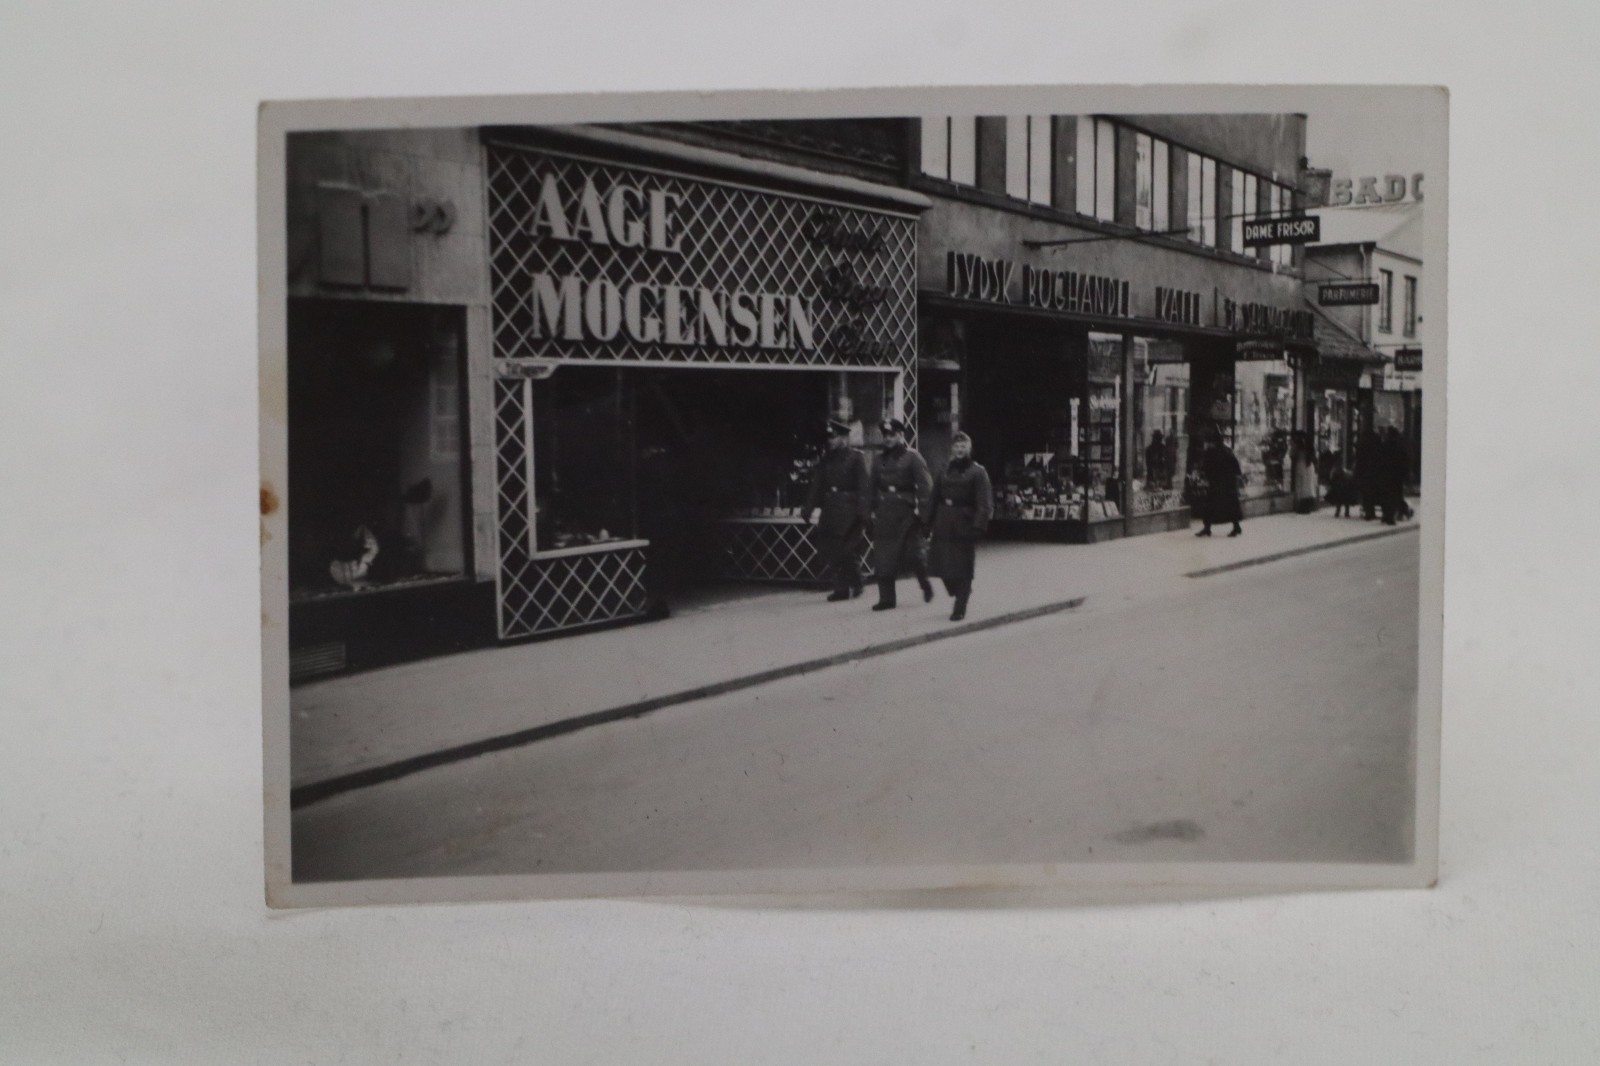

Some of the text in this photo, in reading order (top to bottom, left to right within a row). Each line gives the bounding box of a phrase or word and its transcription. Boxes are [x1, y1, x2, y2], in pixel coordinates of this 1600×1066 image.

[528, 172, 684, 254] AAGE
[1245, 222, 1274, 241] DAME
[530, 272, 816, 351] MOGENSEN
